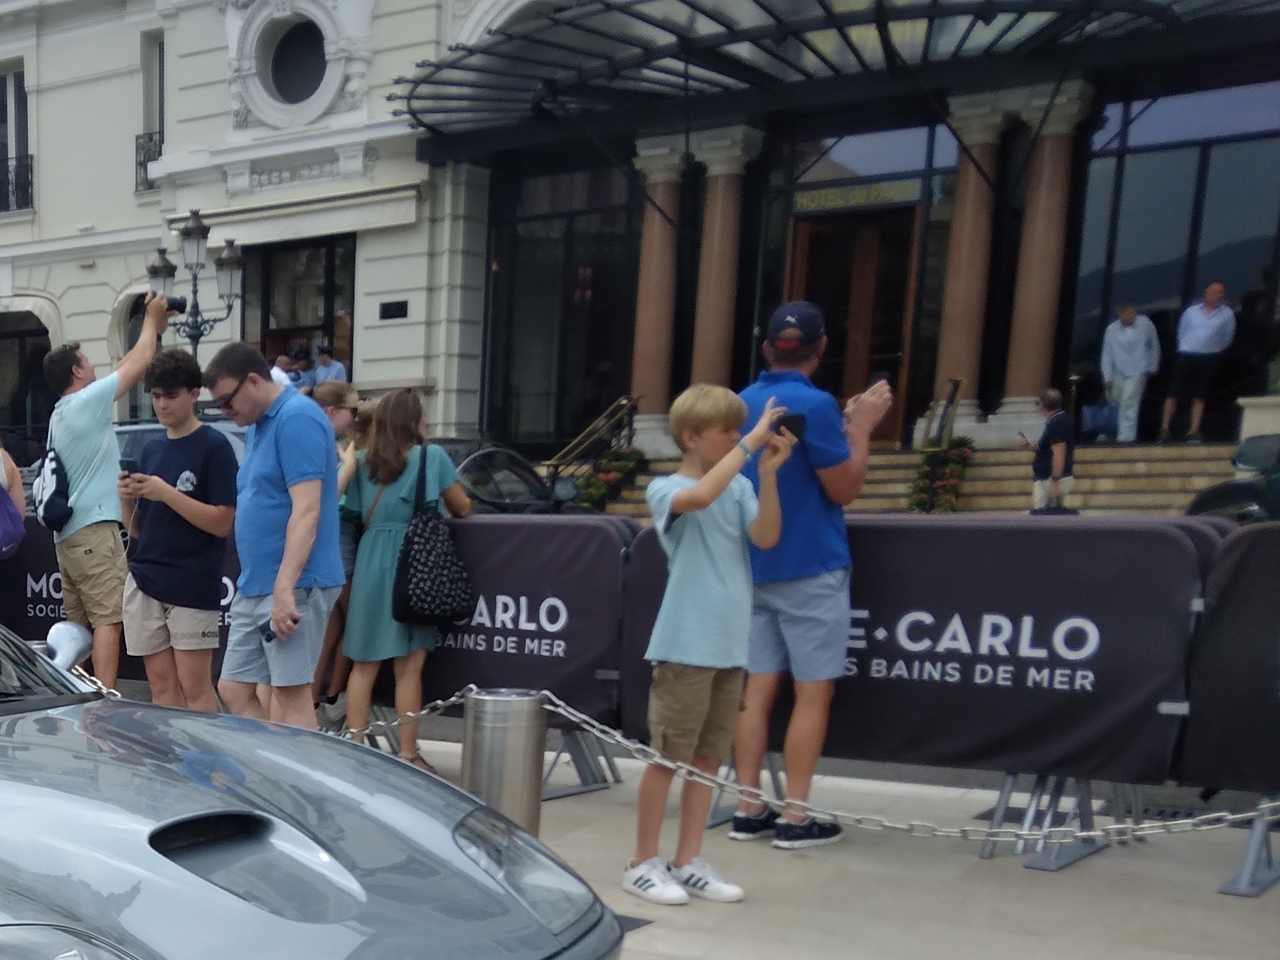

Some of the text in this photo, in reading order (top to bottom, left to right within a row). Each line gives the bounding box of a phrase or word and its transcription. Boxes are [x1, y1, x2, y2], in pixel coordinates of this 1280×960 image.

[26, 572, 64, 599] MO
[453, 594, 569, 632] ARLO
[493, 635, 518, 654] DE
[524, 638, 567, 657] MER
[869, 658, 962, 682] BAINS
[974, 664, 1014, 686] DE
[1027, 667, 1095, 692] MER
